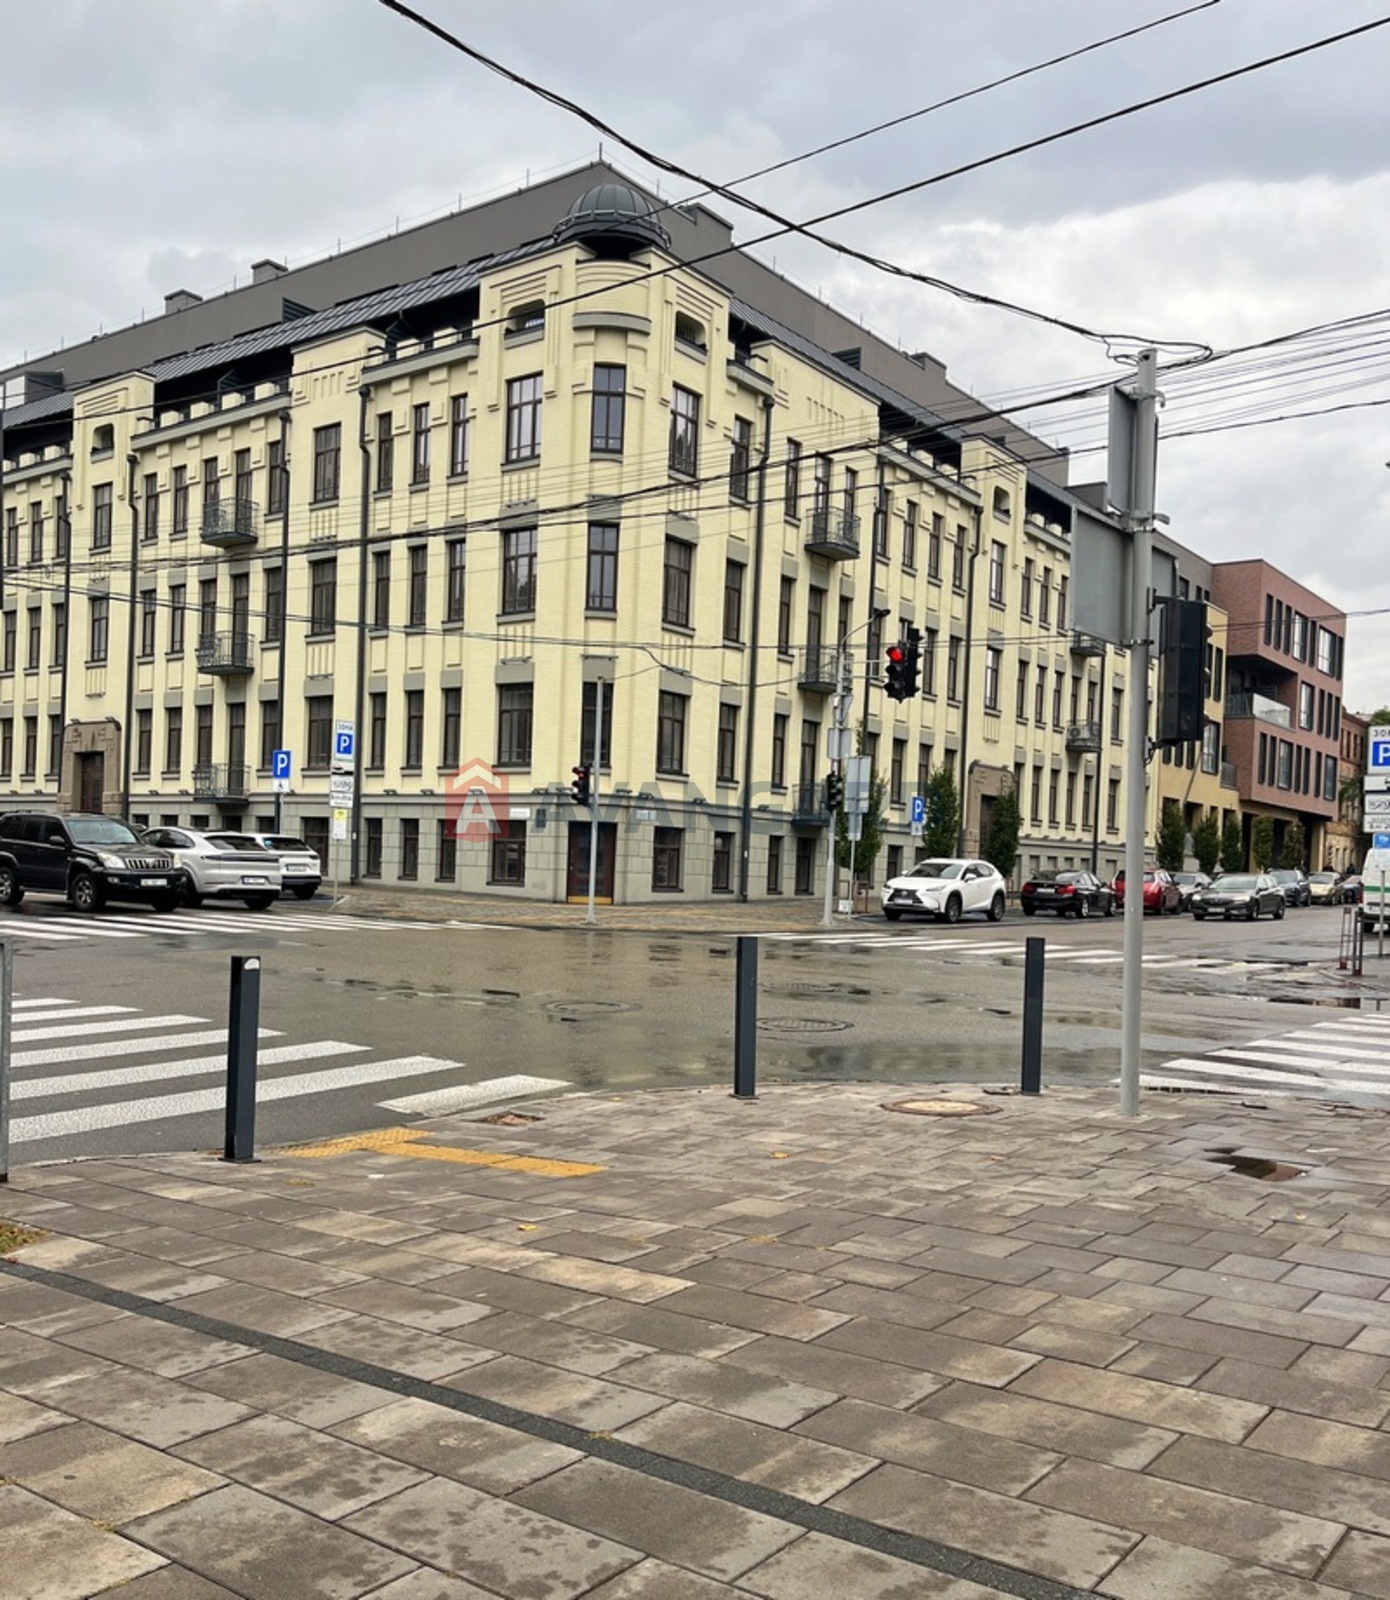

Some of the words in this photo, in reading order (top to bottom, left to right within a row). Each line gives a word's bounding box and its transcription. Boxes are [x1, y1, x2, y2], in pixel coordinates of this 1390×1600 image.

[1373, 729, 1390, 737] ЗО
[340, 735, 350, 752] P
[1378, 743, 1390, 764] P
[277, 753, 288, 776] P
[914, 799, 922, 819] P
